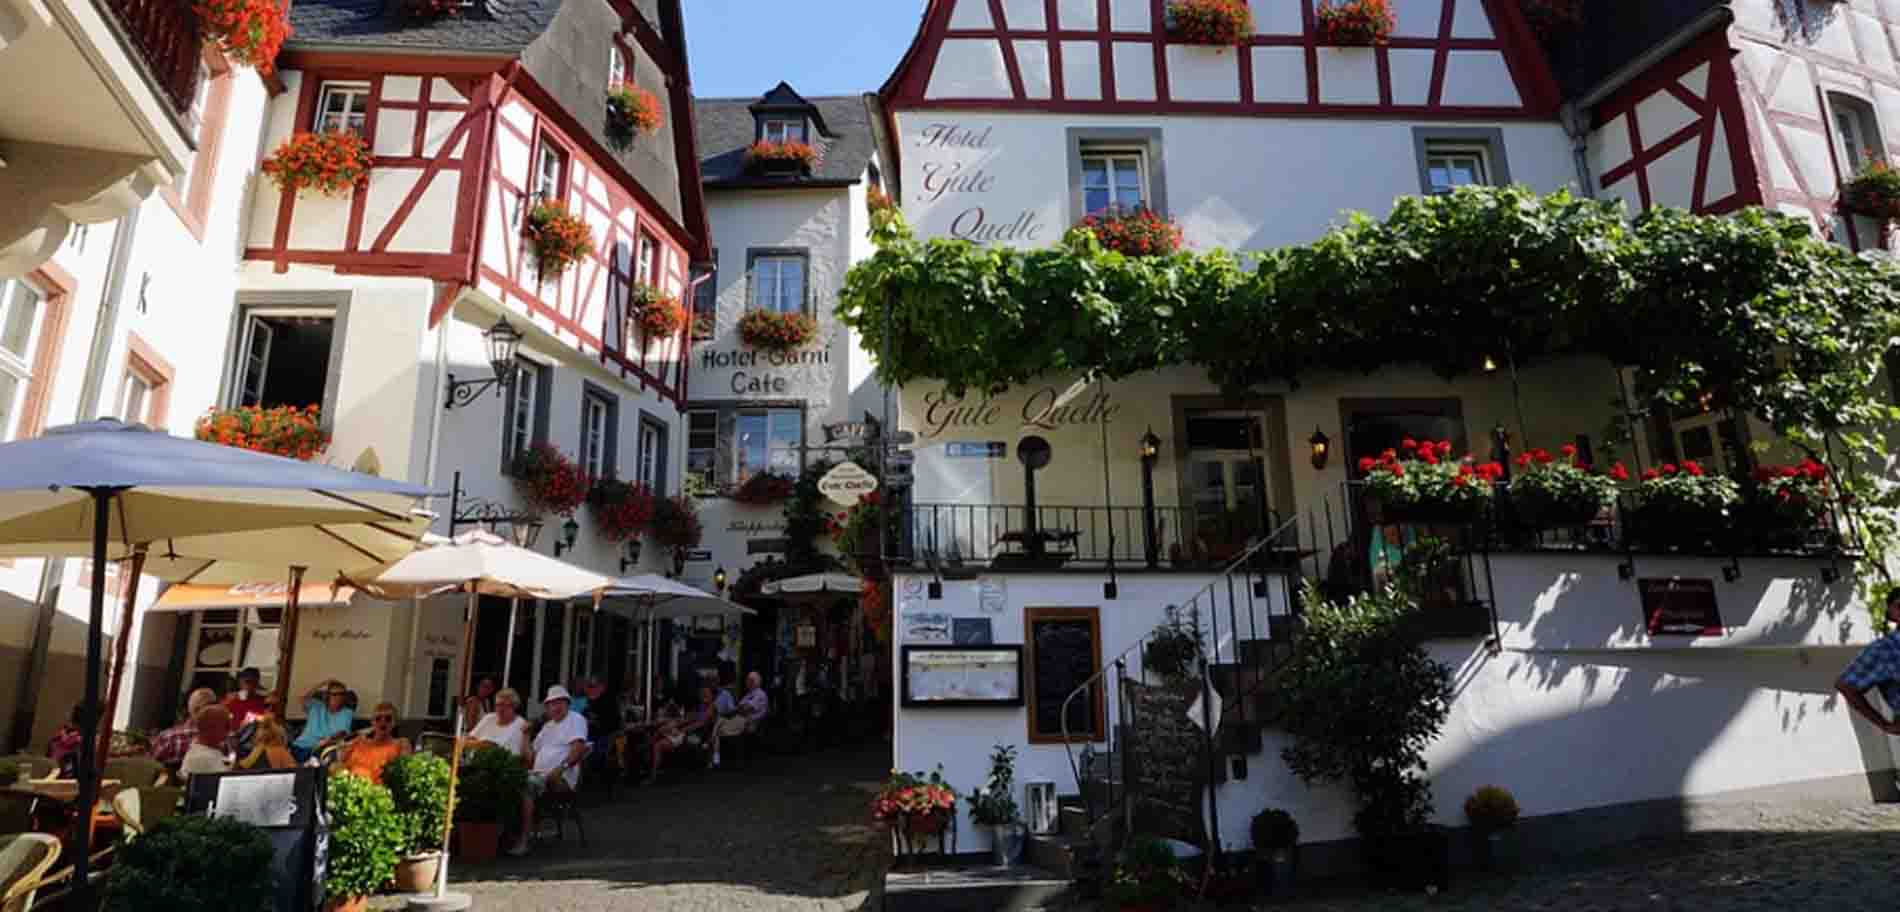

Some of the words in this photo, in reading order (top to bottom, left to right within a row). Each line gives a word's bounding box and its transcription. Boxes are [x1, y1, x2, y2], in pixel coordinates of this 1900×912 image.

[915, 122, 993, 149] Hotel
[916, 160, 997, 201] Gute
[951, 206, 1045, 245] Quelle
[702, 345, 829, 371] Hotel-Garni
[731, 371, 786, 395] Cafe
[919, 390, 1000, 438] Gute
[1020, 386, 1120, 431] Quelle
